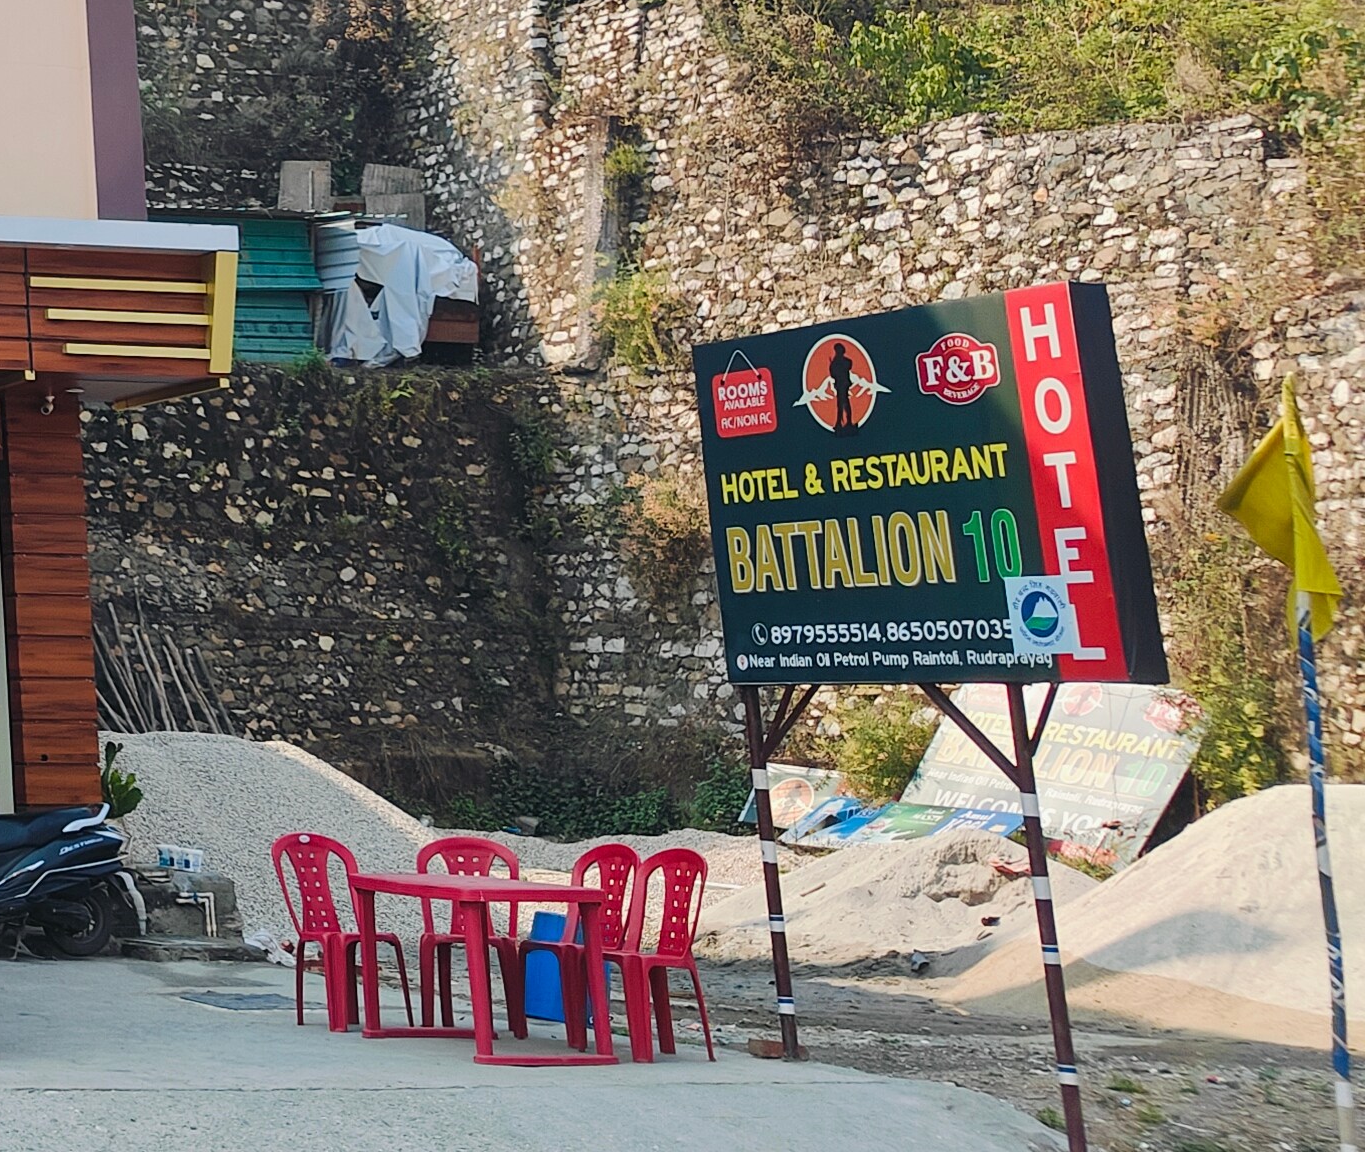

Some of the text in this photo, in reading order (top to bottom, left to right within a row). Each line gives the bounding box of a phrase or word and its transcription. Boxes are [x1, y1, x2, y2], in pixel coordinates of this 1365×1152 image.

[940, 337, 969, 351] FOOD
[923, 349, 995, 386] F&B
[718, 380, 768, 400] ROOMS
[942, 381, 981, 400] BEVERAGE
[723, 397, 765, 411] AVAILABLE
[721, 412, 772, 430] AC/NON AC
[721, 443, 1009, 505] HOTEL & RESTAURANT
[1019, 303, 1107, 660] HOTEL
[725, 508, 1023, 594] BATTALION 10
[770, 617, 1013, 645] 8979555514,8650507035
[749, 650, 1054, 670] Near Indian Oil Petrol Pump Raintoli, Rudraprayag
[1041, 721, 1184, 761] RESTAURANT
[927, 768, 947, 779] Near
[948, 771, 974, 784] Indian
[1120, 759, 1168, 797] 10
[958, 810, 996, 821] Amul
